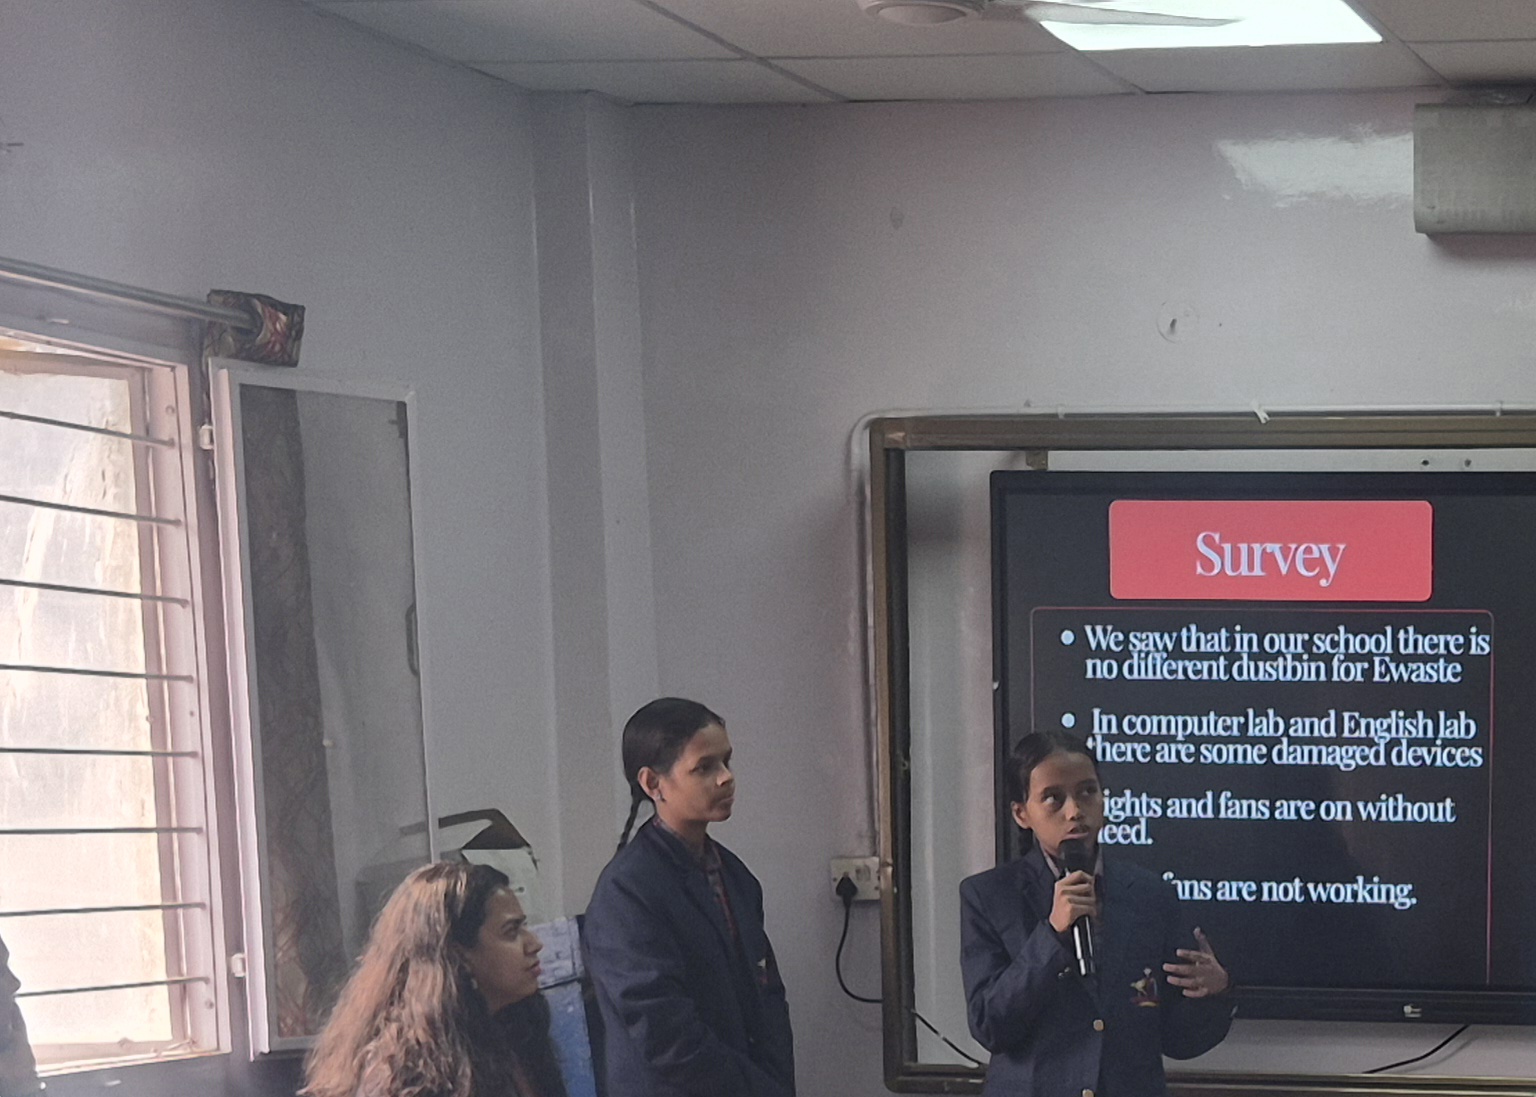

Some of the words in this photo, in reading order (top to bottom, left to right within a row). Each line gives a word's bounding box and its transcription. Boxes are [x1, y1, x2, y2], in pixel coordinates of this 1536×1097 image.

[1196, 531, 1346, 587] Survey
[1084, 624, 1124, 652] We
[1129, 631, 1179, 654] saw
[1181, 624, 1230, 652] that
[1234, 625, 1259, 653] in
[1263, 632, 1309, 654] our
[1313, 626, 1396, 655] school
[1399, 627, 1463, 655] there
[1469, 627, 1490, 655] is
[1084, 657, 1118, 680] no
[1123, 650, 1228, 681] different
[1232, 653, 1326, 682] dustbin
[1331, 655, 1369, 682] for
[1372, 656, 1462, 683] Ewaste
[1092, 708, 1118, 735] In
[1122, 714, 1246, 740] computer
[1247, 708, 1284, 737] lab
[1289, 709, 1337, 738] and
[1342, 710, 1435, 741] English
[1438, 710, 1476, 740] lab
[1155, 741, 1195, 765] are
[1200, 742, 1268, 766] some
[1272, 738, 1386, 770] damaged
[1390, 738, 1483, 768] devices
[1103, 790, 1162, 821] ights
[1167, 790, 1214, 819] and
[1219, 792, 1270, 820] fans
[1275, 797, 1315, 820] are
[1319, 799, 1352, 820] on
[1357, 793, 1456, 823] without
[1217, 878, 1255, 902] are
[1261, 877, 1304, 902] not
[1307, 876, 1417, 910] working.
